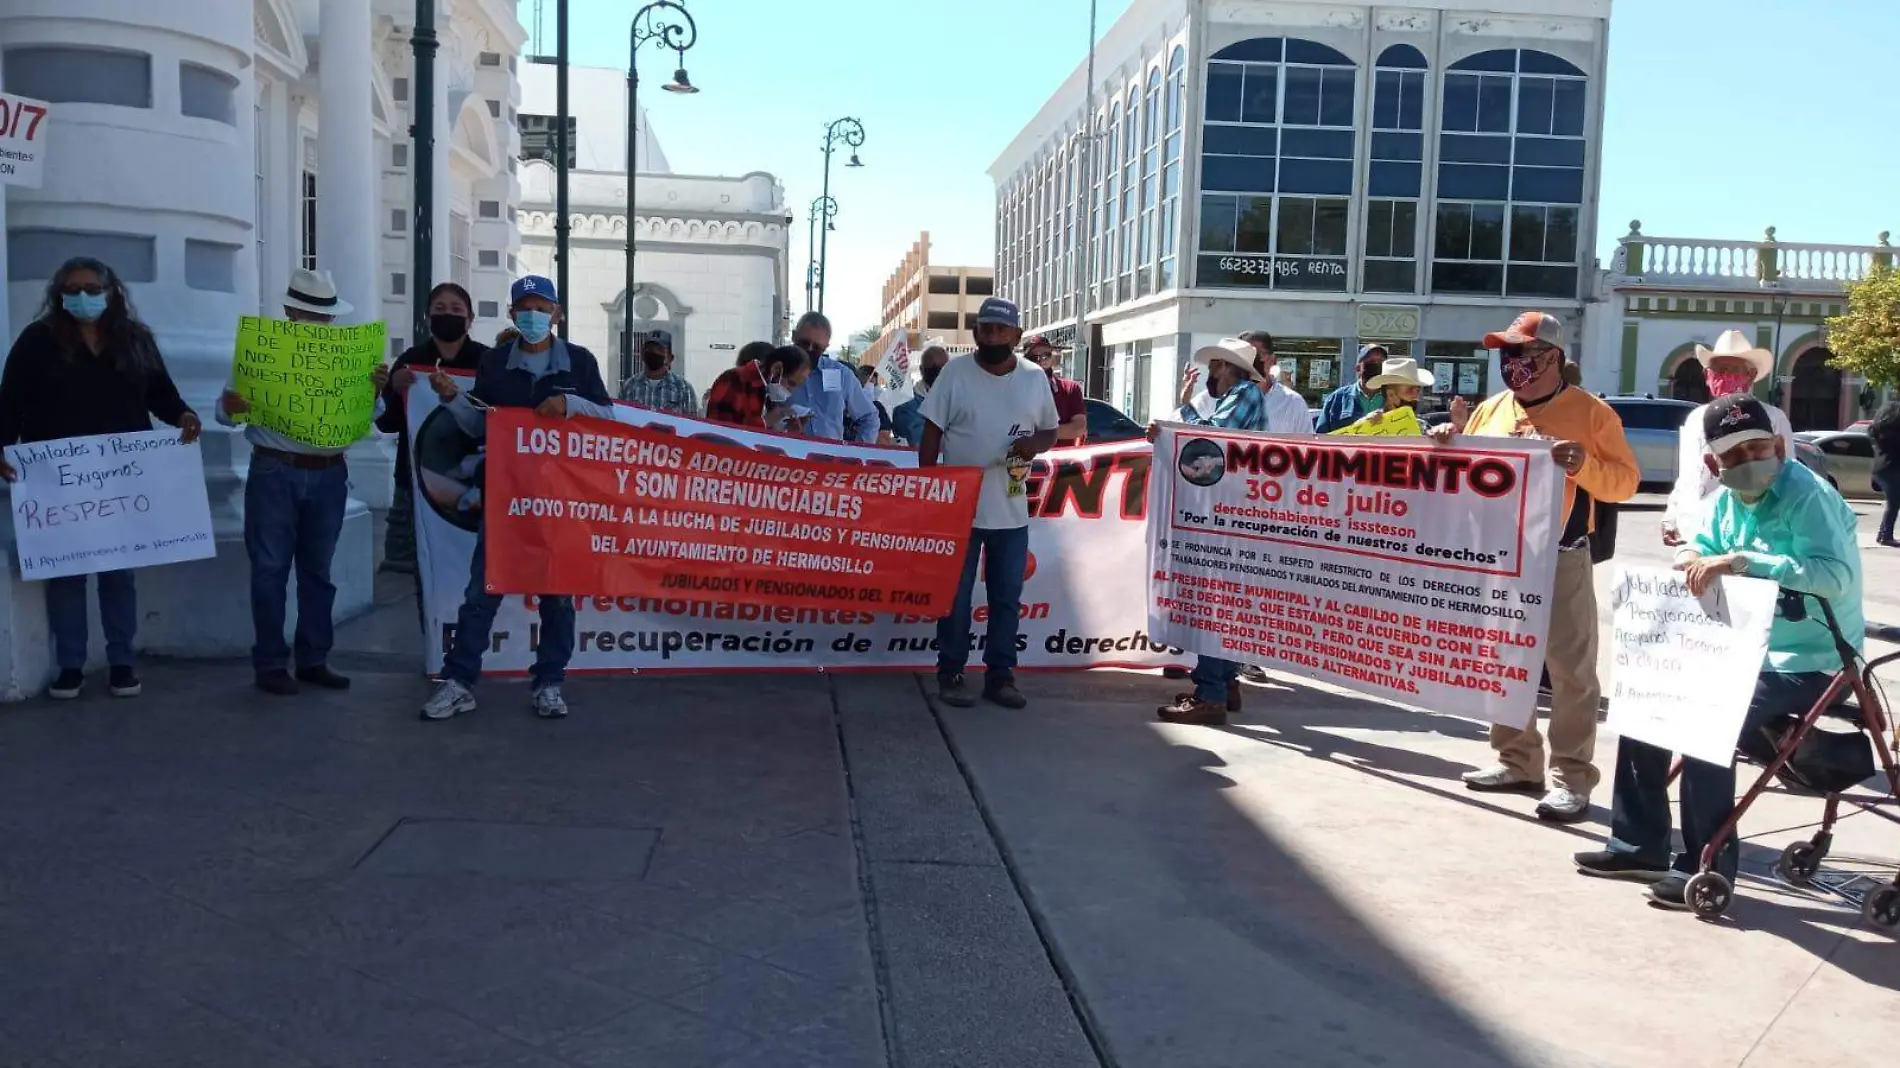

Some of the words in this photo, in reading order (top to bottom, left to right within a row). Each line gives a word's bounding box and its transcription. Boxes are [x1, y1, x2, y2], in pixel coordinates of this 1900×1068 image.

[240, 316, 267, 332] EL
[273, 319, 360, 341] PRESIDENTE
[257, 335, 282, 350] DE
[246, 349, 276, 363] NOS
[238, 362, 324, 389] NUESTROS
[305, 388, 343, 397] COMO
[14, 442, 89, 480] Jubilados
[58, 460, 143, 490] Exigimos
[516, 427, 560, 455] LOS
[567, 432, 683, 468] DERECHOS
[688, 452, 818, 486] ADQUIRIDOS
[822, 472, 849, 488] SE
[853, 473, 956, 503] RESPETAN
[1226, 441, 1516, 498] MOVIMIENTO
[19, 494, 149, 530] RESPETO
[615, 469, 629, 494] Y
[635, 471, 678, 499] SON
[685, 476, 862, 520] IRRENUNCIABLES
[1245, 479, 1282, 502] 30
[1296, 485, 1329, 508] de
[1344, 488, 1408, 517] julio
[508, 498, 563, 516] APOYO
[569, 501, 618, 523] TOTAL
[623, 506, 634, 524] A
[639, 508, 659, 525] LA
[664, 509, 713, 530] LUCHA
[720, 517, 740, 533] DE
[744, 518, 832, 542] JUBILADOS
[837, 529, 848, 543] Y
[851, 530, 956, 556] PENSIONADOS
[1213, 503, 1340, 529] derechohabientes
[1348, 518, 1416, 539] isssteson
[1214, 515, 1225, 526] la
[1231, 518, 1318, 540] recuperación
[1324, 529, 1341, 542] de
[1347, 535, 1408, 552] nuestros
[591, 534, 619, 553] DEL
[624, 538, 747, 563] AYUNTAMIENTO
[753, 548, 771, 565] DE
[777, 551, 873, 575] HERMOSILLO
[1185, 542, 1232, 557] PRONUNCIA
[1239, 550, 1256, 560] POR
[1263, 553, 1272, 562] EL
[1279, 556, 1314, 568] RESPETO
[1320, 562, 1372, 579] IRRESTRICTO
[1380, 572, 1390, 583] DE
[1399, 576, 1415, 587] LOS
[1423, 580, 1480, 597] DERECHOS
[1492, 590, 1508, 600] DE
[1520, 593, 1542, 605] LOS
[660, 574, 739, 592] JUBILADOS
[744, 579, 754, 593] Y
[755, 579, 856, 600] PENSIONADOS
[859, 589, 882, 602] DEL
[890, 590, 931, 606] STAUS
[1154, 570, 1169, 581] AL
[1171, 572, 1242, 593] PRESIDENTE
[1245, 584, 1310, 606] MUNICIPAL
[1314, 597, 1322, 608] Y
[1325, 599, 1340, 612] AL
[1344, 604, 1399, 624] CABILDO
[1403, 615, 1421, 630] DE
[1426, 619, 1537, 648] HERMOSILLO
[1230, 563, 1287, 579] PENSIONADOS
[1289, 571, 1294, 580] Y
[1296, 573, 1340, 589] JUBILADOS
[1342, 581, 1358, 592] DEL
[1359, 584, 1426, 605] AYUNTAMIENTO
[1431, 597, 1446, 608] DE
[1448, 600, 1526, 621] HERMOSILLO,
[443, 623, 509, 653] Pr
[579, 629, 815, 660] recuperación
[831, 632, 872, 652] de
[1157, 596, 1212, 616] PROYECTO
[1216, 608, 1233, 620] DE
[1236, 612, 1316, 639] AUSTERIDAD,
[1323, 628, 1354, 646] PERO
[1357, 637, 1384, 653] QUE
[1388, 644, 1413, 660] SEA
[1418, 652, 1445, 666] SIN
[1450, 657, 1528, 682] AFECTAR
[1177, 586, 1194, 599] LES
[1197, 591, 1252, 609] DECIMOS
[1259, 602, 1285, 616] QUE
[1288, 607, 1343, 628] ESTAMOS
[1347, 620, 1363, 632] DE
[1367, 624, 1431, 647] ACUERDO
[1437, 638, 1472, 655] CON
[1478, 645, 1499, 659] EL
[1169, 612, 1187, 625] LOS
[1190, 617, 1255, 638] DERECHOS
[1259, 630, 1275, 643] DE
[1278, 634, 1301, 649] LOS
[1305, 640, 1391, 671] PENSIONADOS
[1396, 662, 1405, 675] Y
[1409, 665, 1507, 697] JUBILADOS,
[1222, 637, 1277, 658] EXISTEN
[1279, 650, 1319, 668] OTRAS
[1322, 660, 1420, 694] ALTERNATIVAS.
